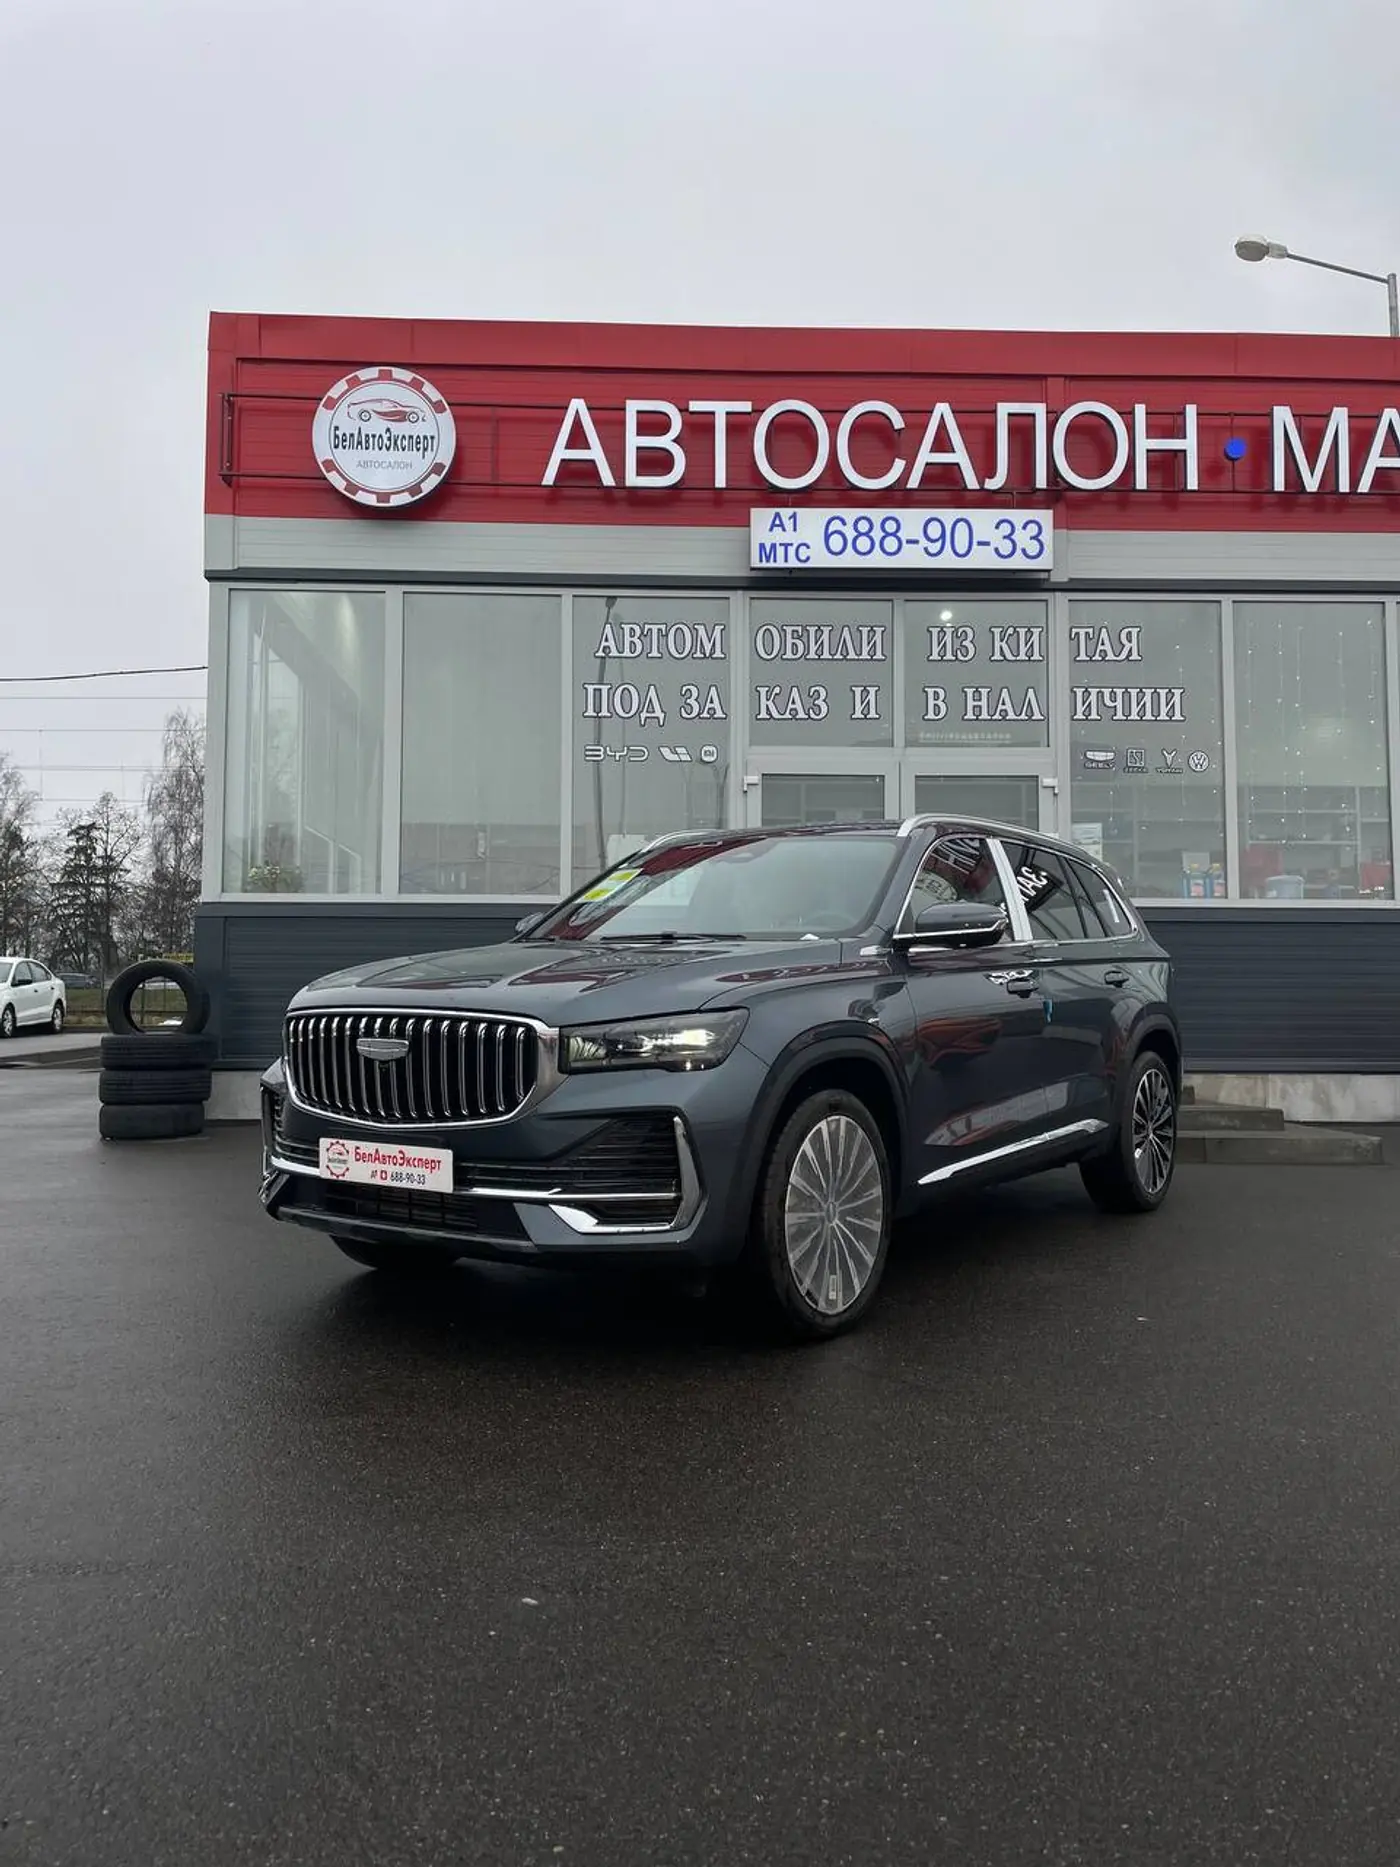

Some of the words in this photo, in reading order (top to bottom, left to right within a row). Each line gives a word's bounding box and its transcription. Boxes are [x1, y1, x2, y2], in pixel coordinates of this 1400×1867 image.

[333, 426, 436, 459] БелАвтоЭксперт
[541, 397, 1199, 492] АВТОСАЛОН
[1272, 405, 1400, 493] МА
[356, 460, 413, 470] АВТОСАЛОН
[758, 542, 811, 563] МТС
[823, 515, 1045, 561] 688-90-33
[926, 625, 977, 662] ИЗ
[583, 682, 667, 727] ПОД
[850, 685, 881, 721] И
[922, 686, 948, 721] В
[354, 1146, 442, 1173] БелАвтоЭксперт
[390, 1171, 426, 1185] 688-90-33
